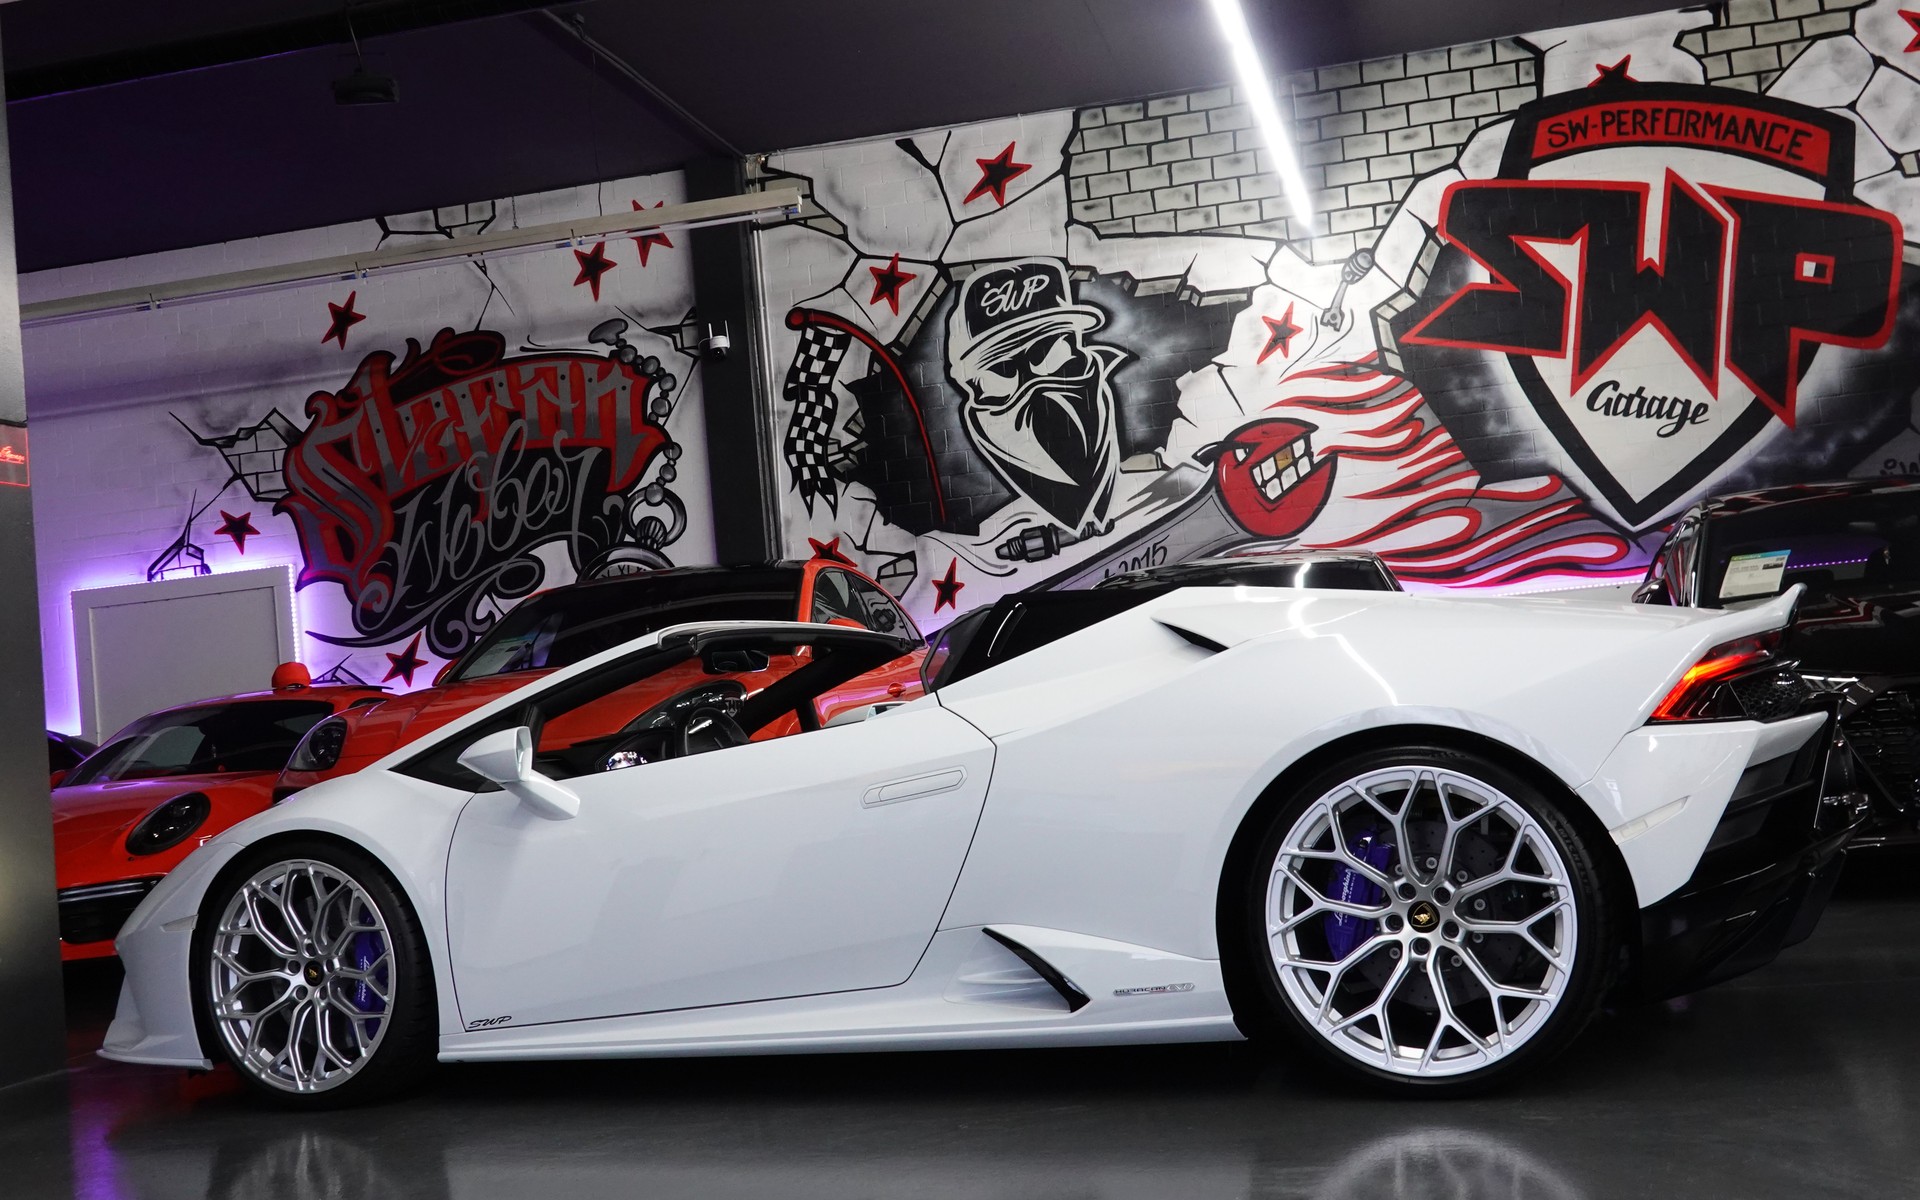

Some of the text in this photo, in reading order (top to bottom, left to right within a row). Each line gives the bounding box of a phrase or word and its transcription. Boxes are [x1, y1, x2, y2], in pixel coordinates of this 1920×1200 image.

[1547, 107, 1813, 161] SW-PERFORMANCE
[980, 274, 1050, 317] SWP
[1400, 167, 1904, 431] SWP
[1586, 379, 1710, 438] Garage
[468, 1015, 512, 1029] SWP
